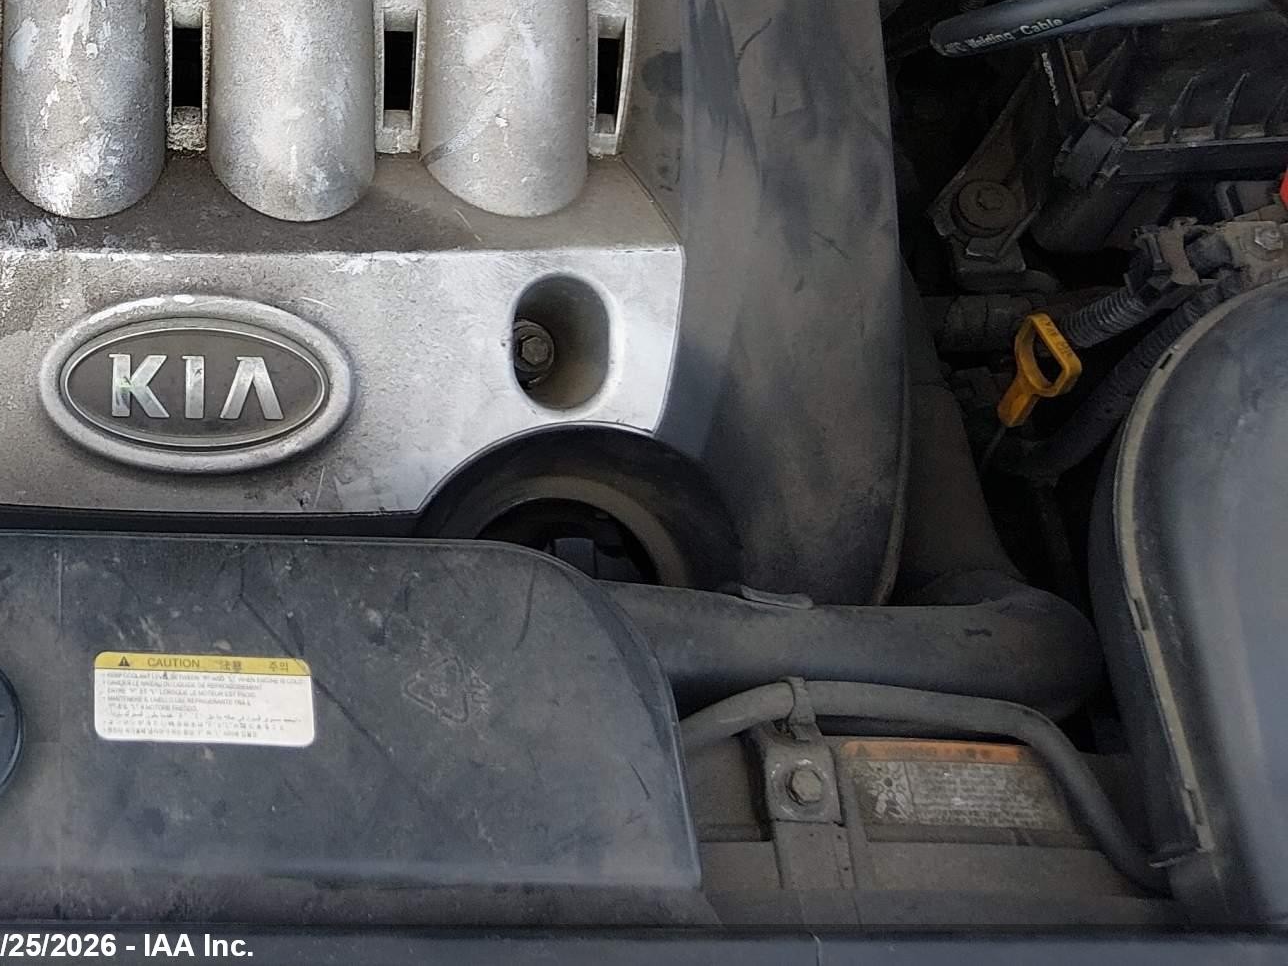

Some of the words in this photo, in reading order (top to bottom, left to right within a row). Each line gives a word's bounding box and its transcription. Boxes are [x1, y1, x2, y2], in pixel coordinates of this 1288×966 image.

[1019, 17, 1063, 35] Cable
[109, 353, 284, 420] KIA
[147, 657, 200, 668] CAUTION
[268, 661, 289, 673] 주의
